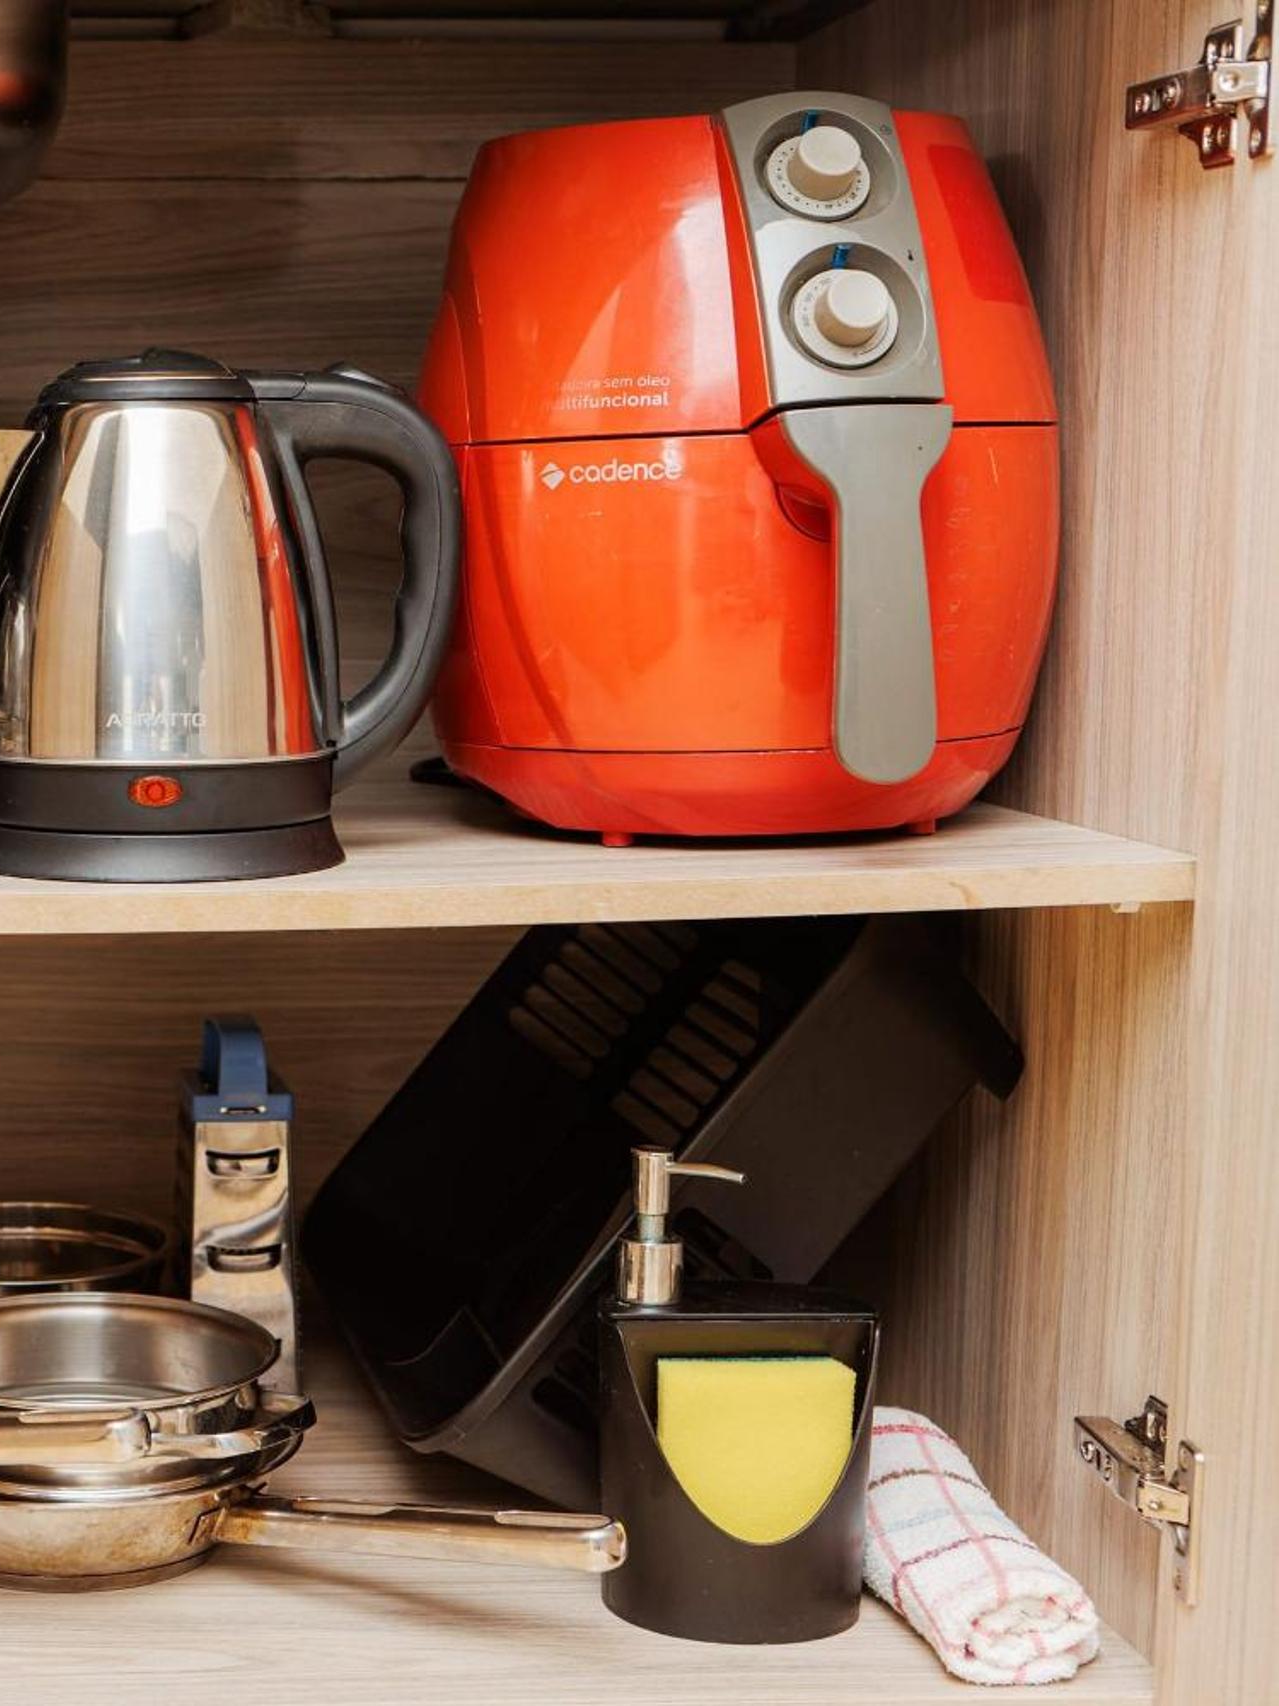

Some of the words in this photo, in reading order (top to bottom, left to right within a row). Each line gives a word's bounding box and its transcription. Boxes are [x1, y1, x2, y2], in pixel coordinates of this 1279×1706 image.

[602, 377, 634, 389] sem
[569, 458, 683, 484] cadence
[106, 711, 207, 728] ARATTO
